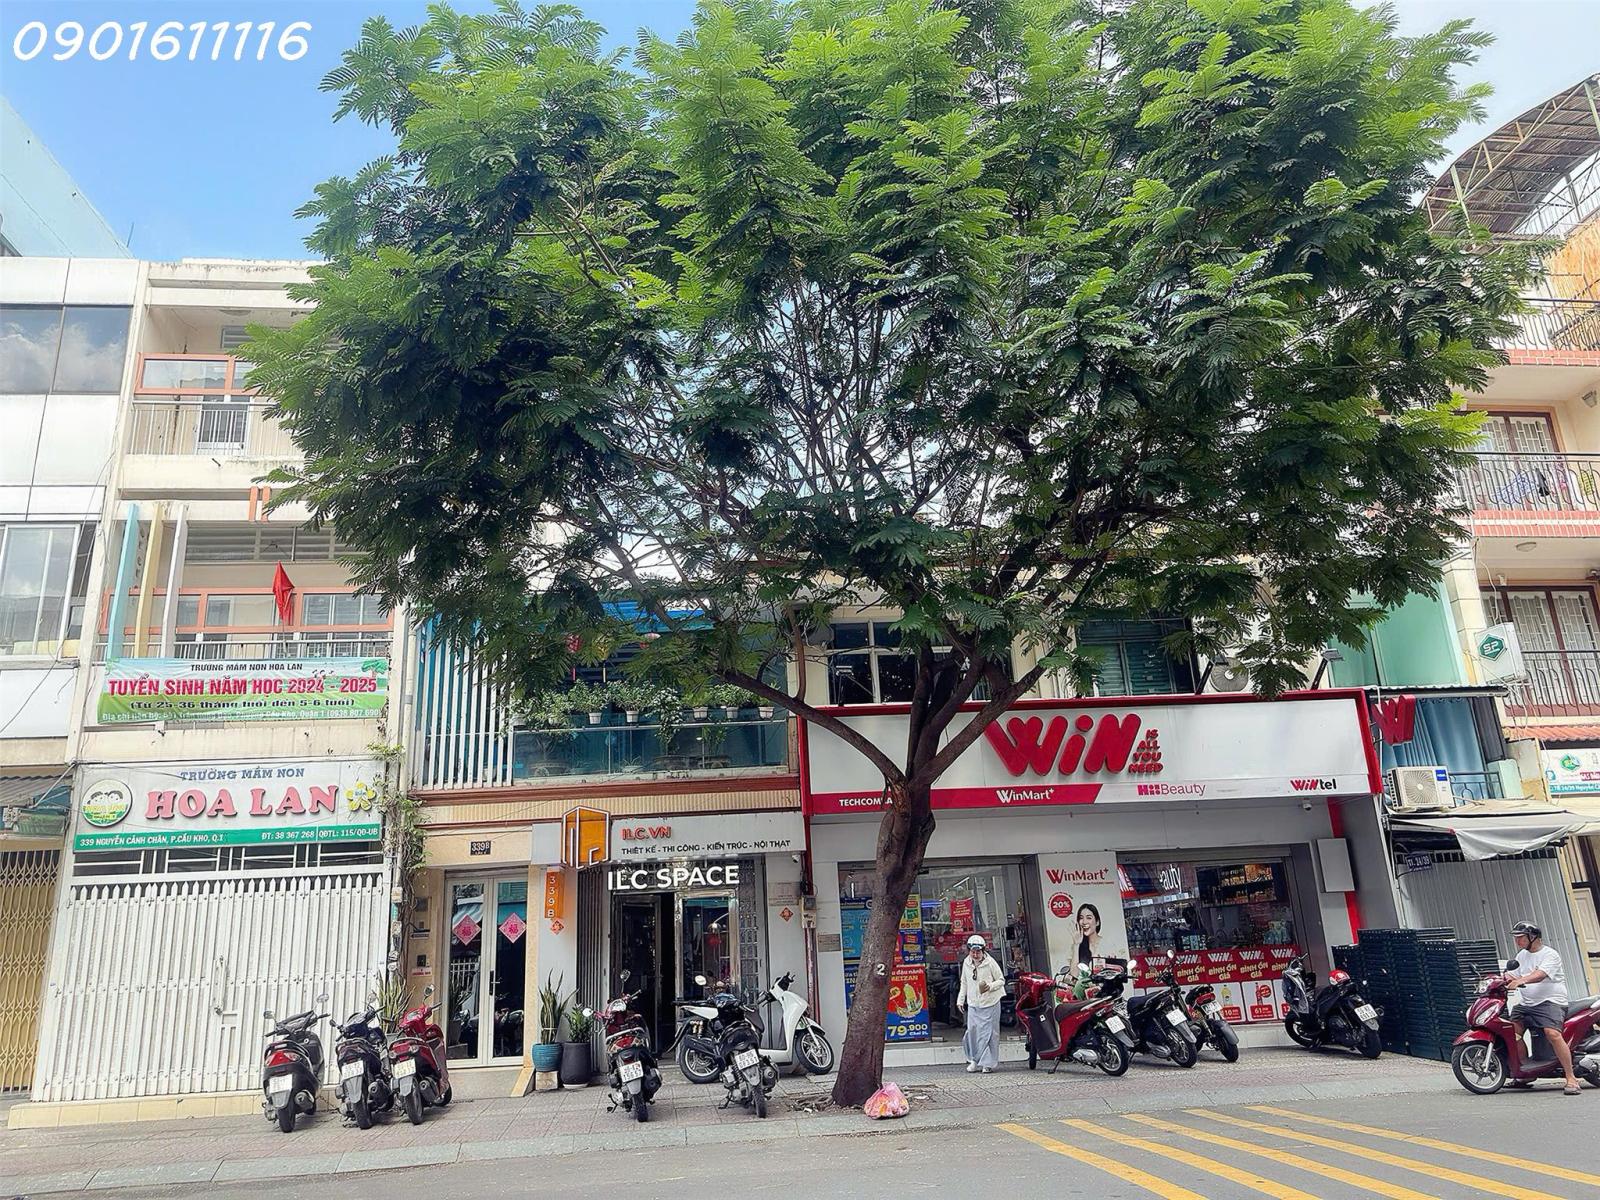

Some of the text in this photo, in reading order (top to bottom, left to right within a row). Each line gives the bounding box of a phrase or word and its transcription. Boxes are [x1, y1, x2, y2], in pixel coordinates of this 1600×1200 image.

[249, 663, 267, 671] NON
[268, 663, 285, 671] HOA
[287, 662, 303, 671] LAN
[108, 673, 160, 696] TUYỂN
[164, 679, 204, 696] SINH
[208, 675, 247, 695] NĂM
[252, 678, 283, 697] HỌC
[287, 678, 324, 693] 2024
[340, 678, 377, 693] 2025
[156, 701, 195, 709] 25-36
[300, 699, 321, 707] 5-6
[1146, 729, 1159, 740] IS
[1137, 740, 1161, 751] ALL
[1133, 751, 1162, 762] YOU
[180, 768, 237, 781] TRƯỜNG
[276, 767, 305, 778] NON
[1128, 762, 1164, 774] NEED
[145, 785, 339, 819] HOA LAN
[80, 838, 95, 847] 339
[95, 835, 125, 846] NGUYỄN
[193, 834, 211, 843] KHO,
[212, 833, 224, 842] Q.1
[274, 832, 286, 840] 38
[287, 831, 299, 840] 367
[300, 830, 315, 839] 268
[621, 826, 672, 841] ILC.VN
[662, 845, 675, 853] THI
[677, 843, 700, 853] CÔNG
[727, 840, 748, 850] TRÚC
[607, 865, 740, 891] ILC SPACE
[1053, 901, 1070, 909] 20%
[877, 963, 886, 976] 2
